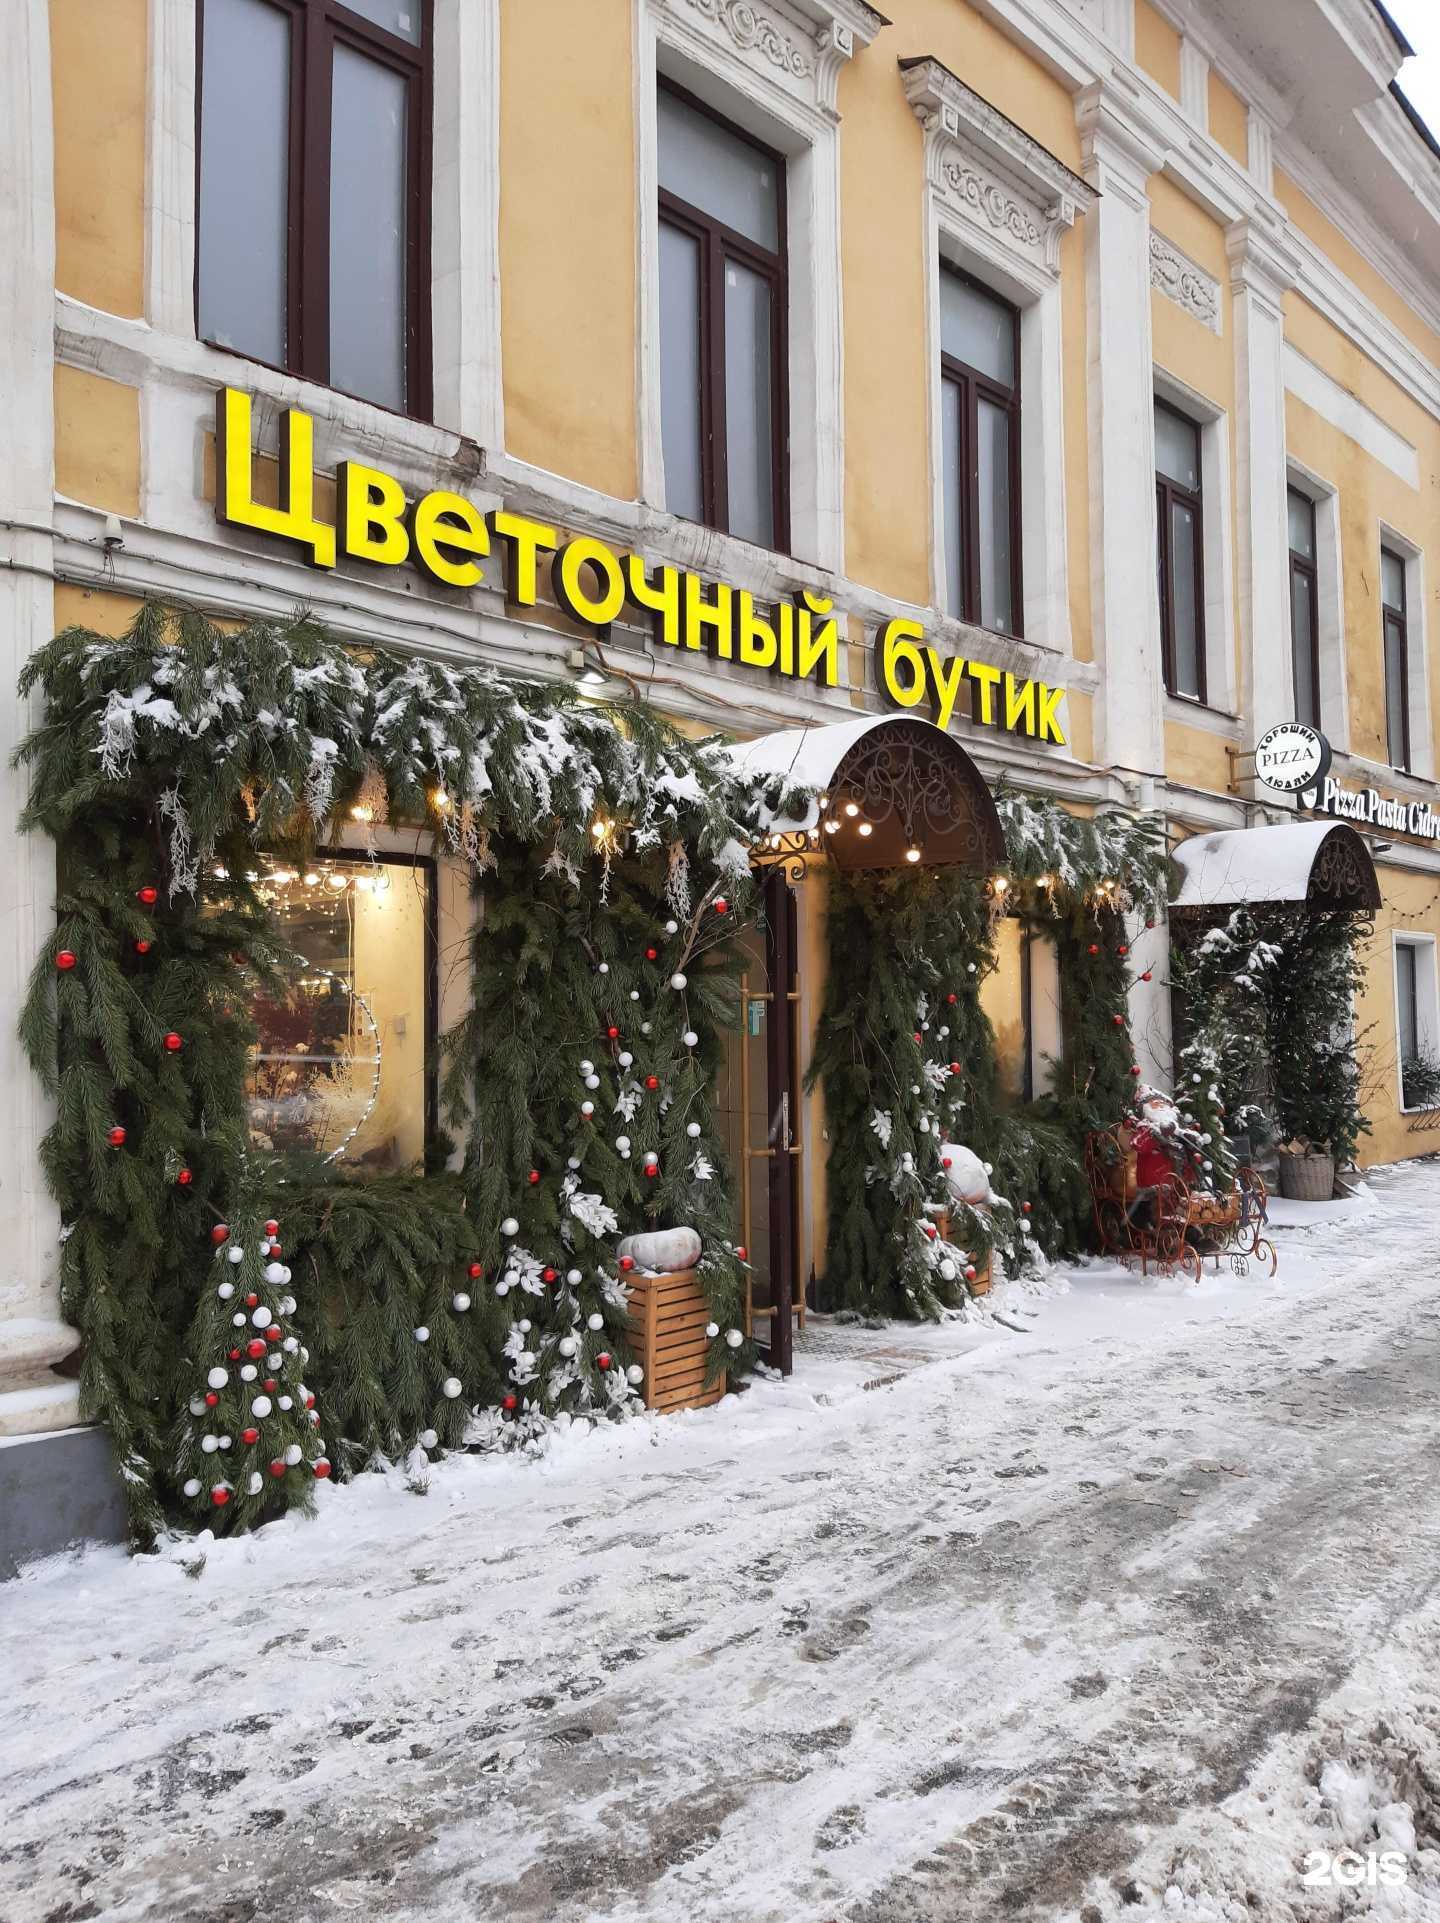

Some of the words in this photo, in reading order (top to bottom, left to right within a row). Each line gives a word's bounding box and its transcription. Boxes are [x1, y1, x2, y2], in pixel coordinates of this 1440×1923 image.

[224, 387, 838, 687] Цветочный
[880, 617, 1067, 746] бутик
[1262, 747, 1315, 767] PIZZA
[1265, 770, 1311, 789] ЛЮДЯМ
[1365, 788, 1407, 832] Pasta
